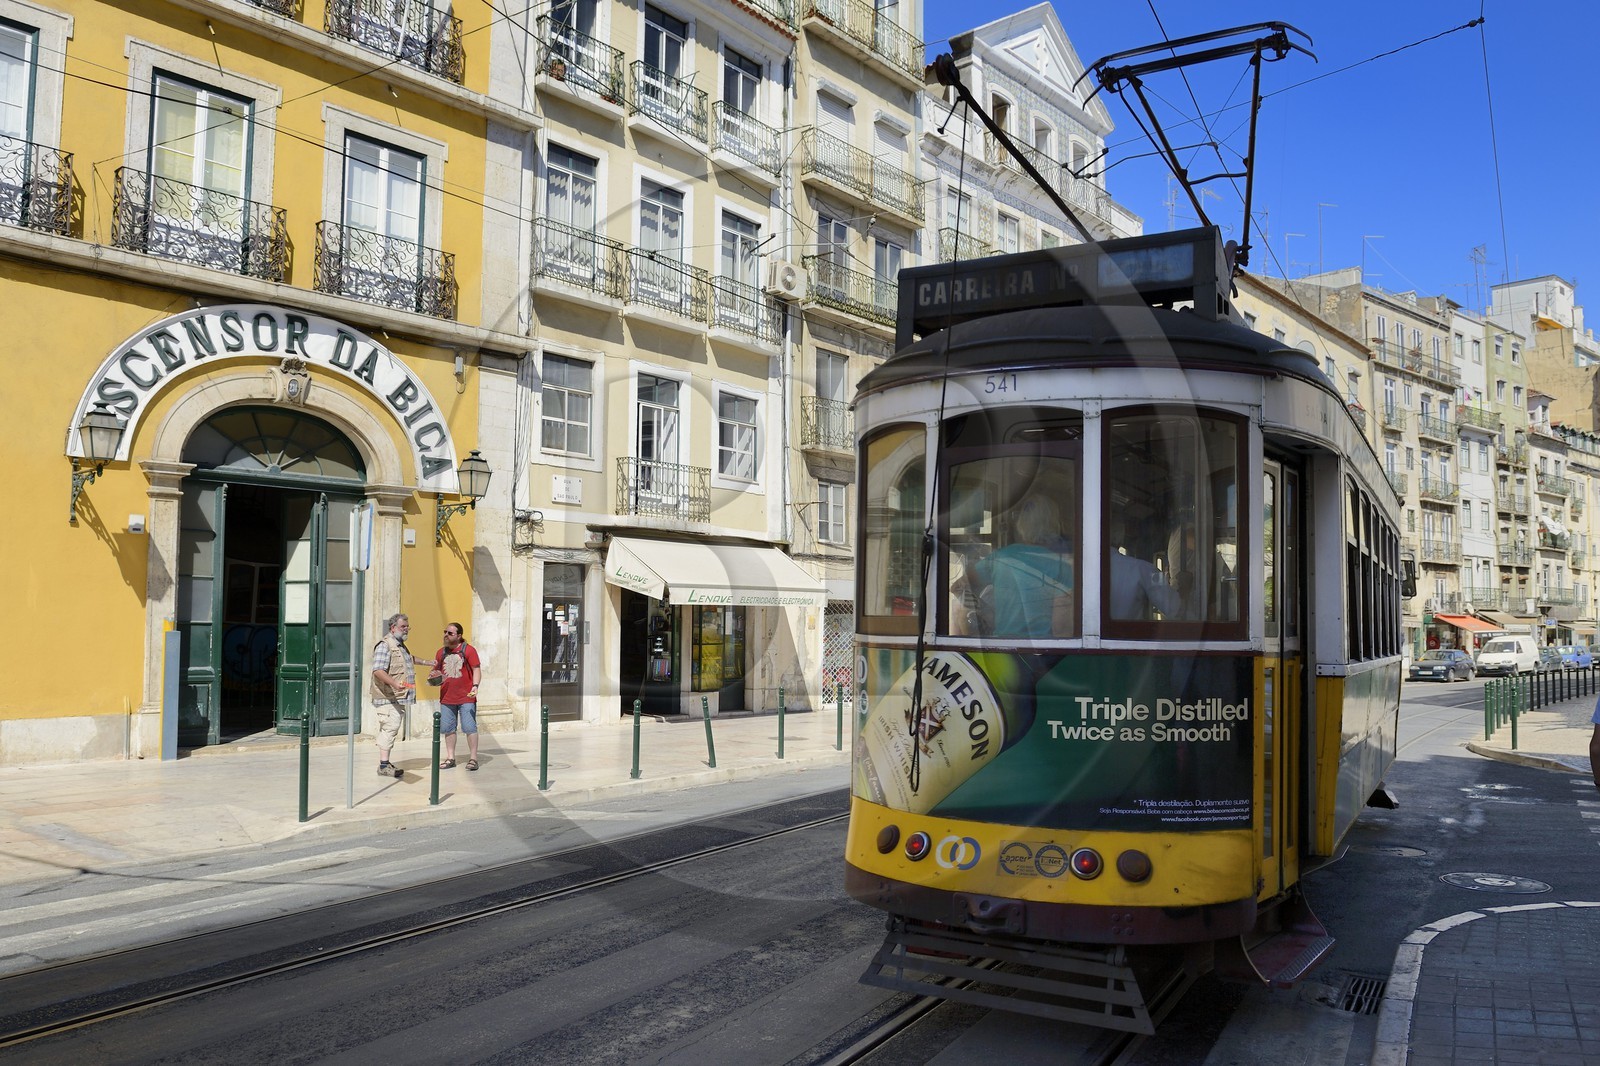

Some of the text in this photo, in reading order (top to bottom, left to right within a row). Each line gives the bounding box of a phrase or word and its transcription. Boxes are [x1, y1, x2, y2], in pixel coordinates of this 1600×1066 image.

[918, 270, 1036, 307] CARREIRA
[985, 374, 1018, 394] 541
[97, 310, 452, 481] SCENSOR DA BICA
[615, 566, 649, 585] LENAVE
[687, 589, 734, 603] LENAVE
[1074, 696, 1249, 726] Triple Distilled
[1047, 720, 1115, 741] Twice
[1119, 726, 1146, 741] as
